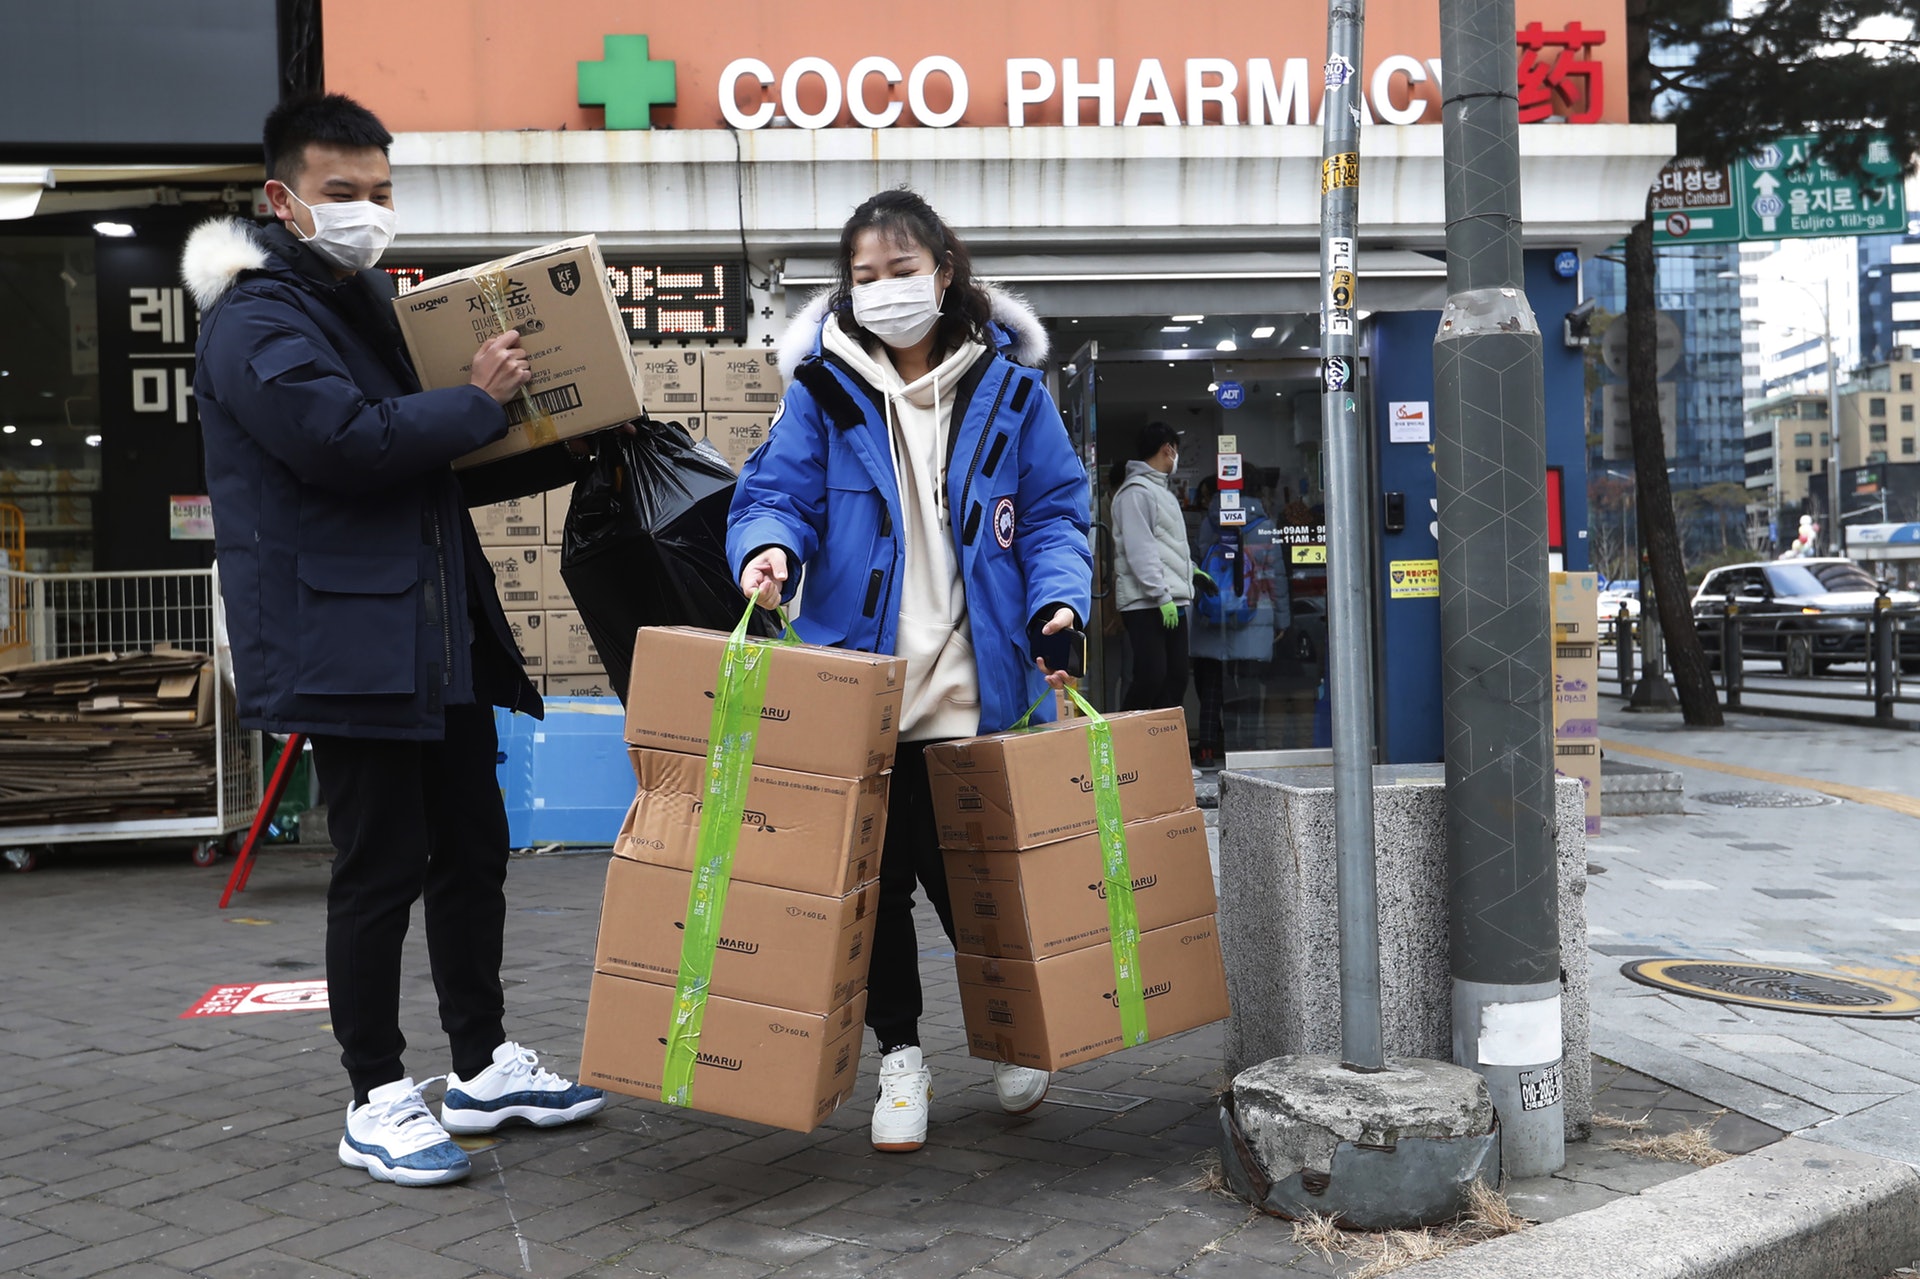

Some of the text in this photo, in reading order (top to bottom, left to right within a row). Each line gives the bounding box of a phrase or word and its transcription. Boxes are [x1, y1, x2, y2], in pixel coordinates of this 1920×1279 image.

[1517, 21, 1606, 125] 药
[718, 52, 1442, 130] COCO PHARMC
[1685, 190, 1727, 206] Cathedral
[1759, 200, 1776, 213] 60
[1791, 216, 1836, 231] Euljiro
[1559, 259, 1576, 270] ADT
[556, 269, 572, 283] KF
[558, 280, 575, 293] 94
[466, 277, 531, 315] 자숲
[410, 294, 449, 312] ILDONG
[645, 358, 679, 374] 자연숲
[727, 358, 760, 374] 자연숲
[1221, 389, 1240, 400] ADT
[730, 423, 762, 439] 자연숲
[1224, 512, 1243, 521] VISA
[1258, 528, 1283, 536] Mon-Sat
[1283, 525, 1309, 535] 09AM
[1284, 534, 1310, 544] 11AM
[1315, 551, 1326, 562] 3,
[1564, 694, 1587, 704] 마스크
[1566, 726, 1592, 735] KF-94
